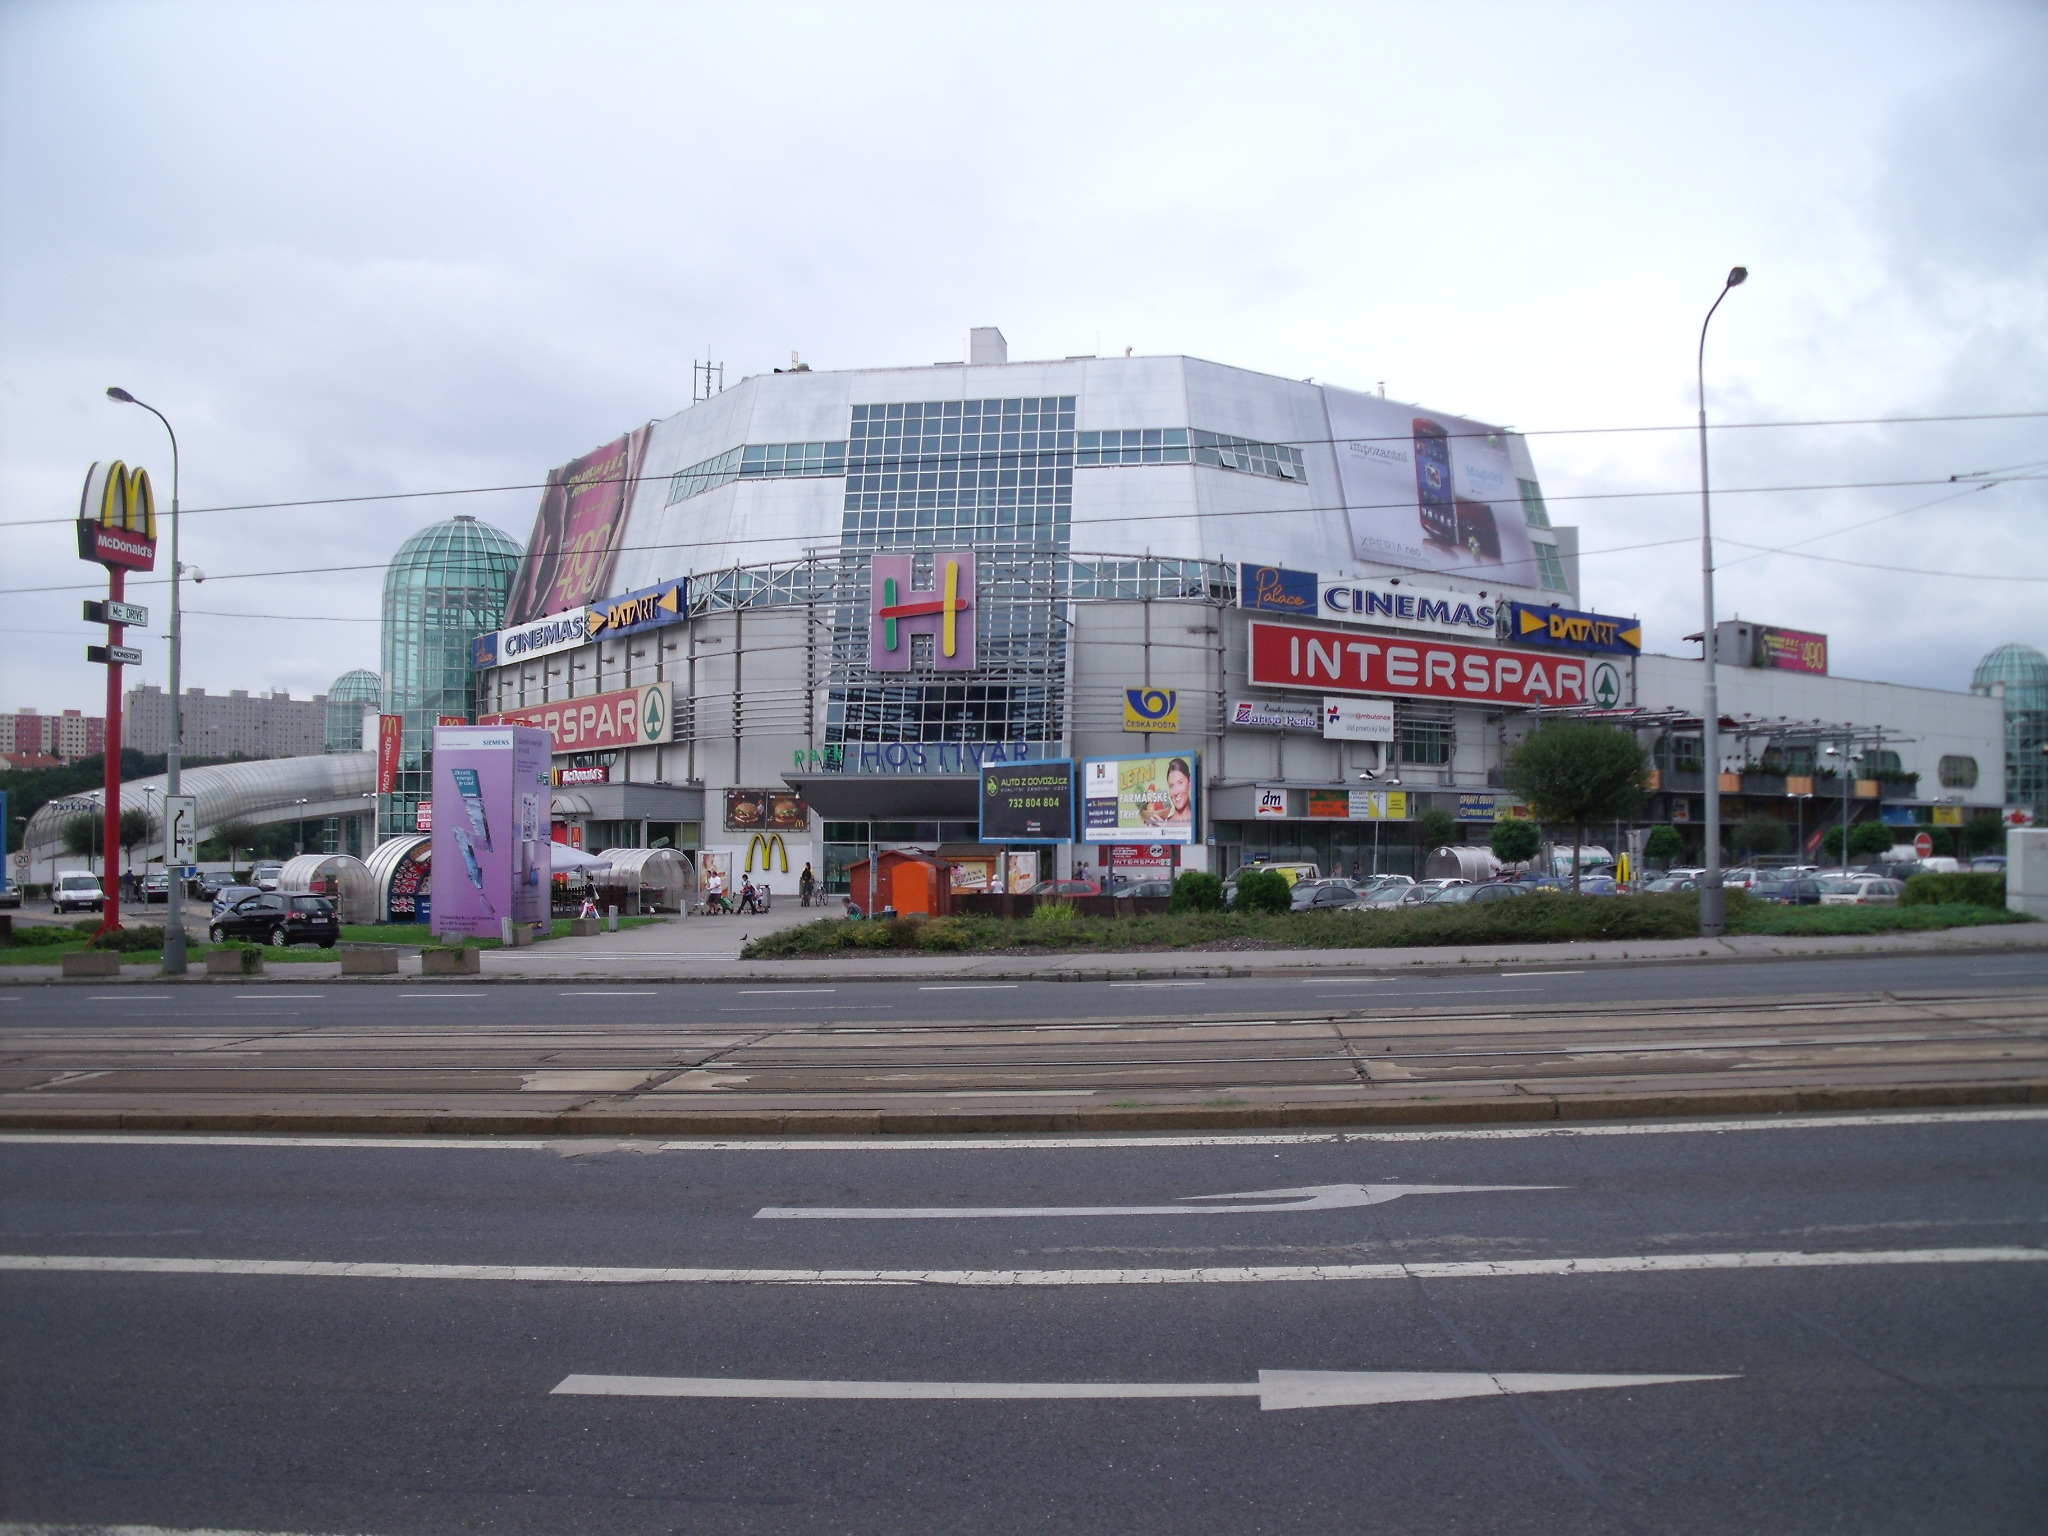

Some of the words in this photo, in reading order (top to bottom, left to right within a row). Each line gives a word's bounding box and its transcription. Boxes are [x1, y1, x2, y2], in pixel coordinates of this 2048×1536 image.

[98, 535, 153, 558] McDonald's
[1360, 537, 1402, 553] XPERIA
[1405, 546, 1421, 557] neo
[1255, 567, 1306, 606] Palace
[112, 606, 122, 617] Mc
[126, 608, 143, 621] DRIVE
[607, 593, 659, 629] DATART
[1324, 586, 1496, 628] CINEMAS
[505, 616, 584, 656] CINEMAS
[1549, 613, 1620, 646] DATART
[113, 650, 140, 660] NONSTOP
[1291, 636, 1584, 699] INTERSPAR
[1126, 720, 1151, 728] ČESKÁ
[1152, 721, 1177, 729] POŠTA
[794, 743, 844, 766] park
[861, 733, 1029, 768] HOSTIVAŘ
[562, 768, 603, 781] McDonald's
[1001, 779, 1021, 787] AUTO
[1120, 759, 1156, 791] LETNÍ
[1009, 799, 1023, 808] 732
[1025, 798, 1041, 807] 804
[1044, 797, 1059, 807] 804
[1262, 791, 1281, 805] dm
[52, 802, 96, 813] parking
[1119, 810, 1140, 820] TRHY
[18, 855, 29, 864] 20
